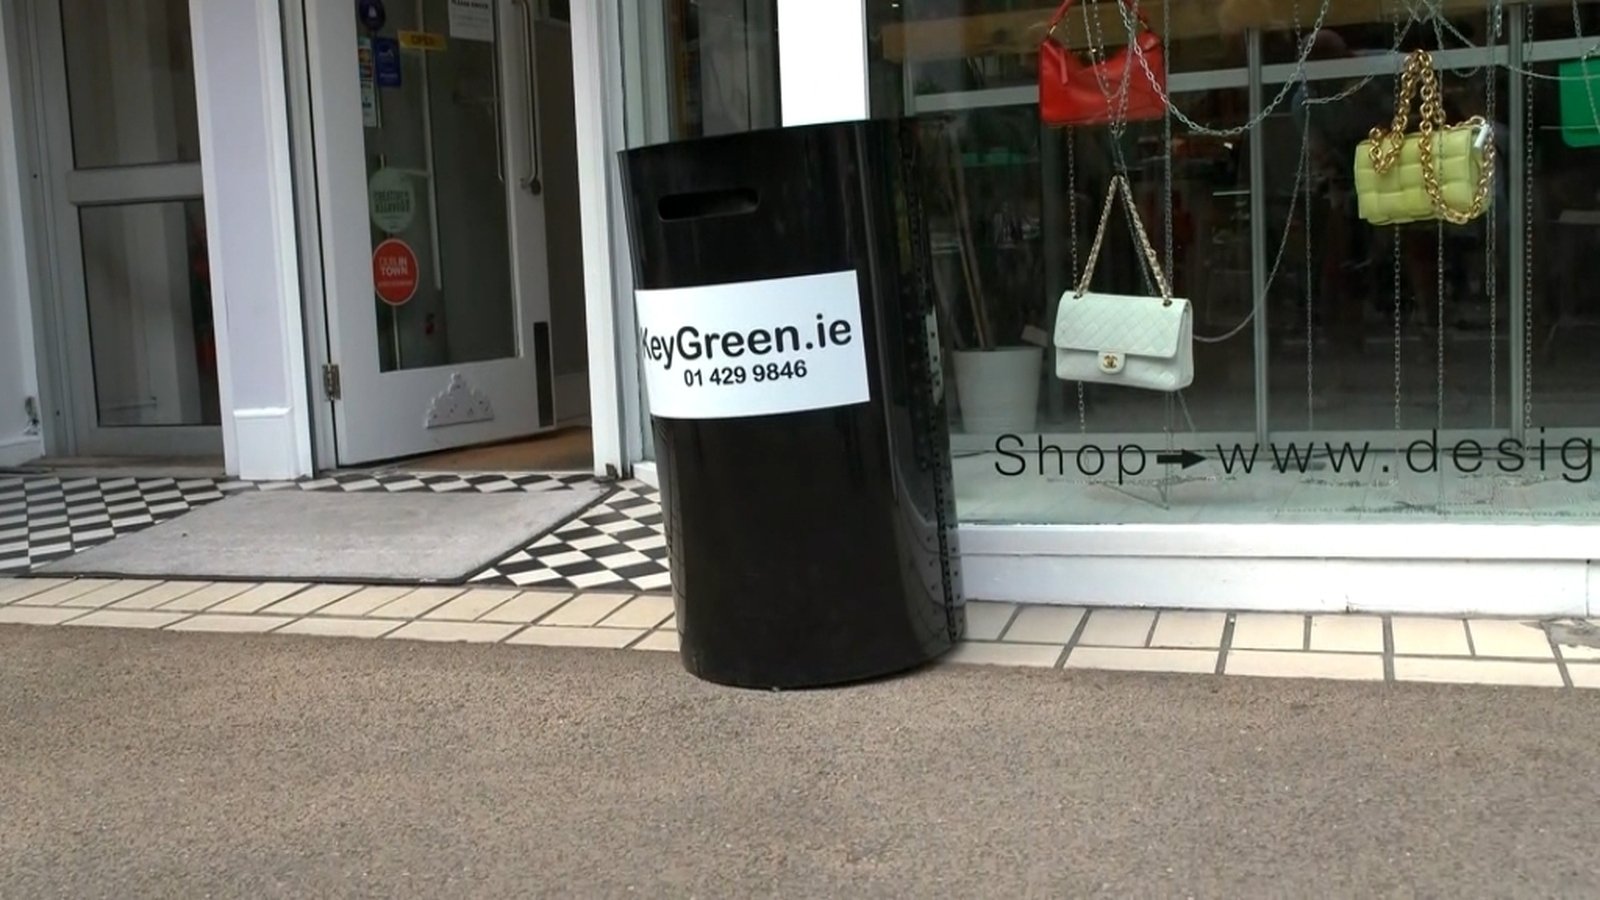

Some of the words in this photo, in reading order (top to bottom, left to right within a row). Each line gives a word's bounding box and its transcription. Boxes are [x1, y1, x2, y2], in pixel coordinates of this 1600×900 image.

[379, 256, 407, 266] DUBLIN
[381, 264, 408, 276] TOWN
[640, 313, 852, 370] KeyGreen.ie
[684, 369, 703, 387] 01
[710, 366, 746, 385] 429
[752, 359, 808, 382] 9846
[994, 433, 1146, 485] Shop
[1215, 426, 1592, 483] www.desig
